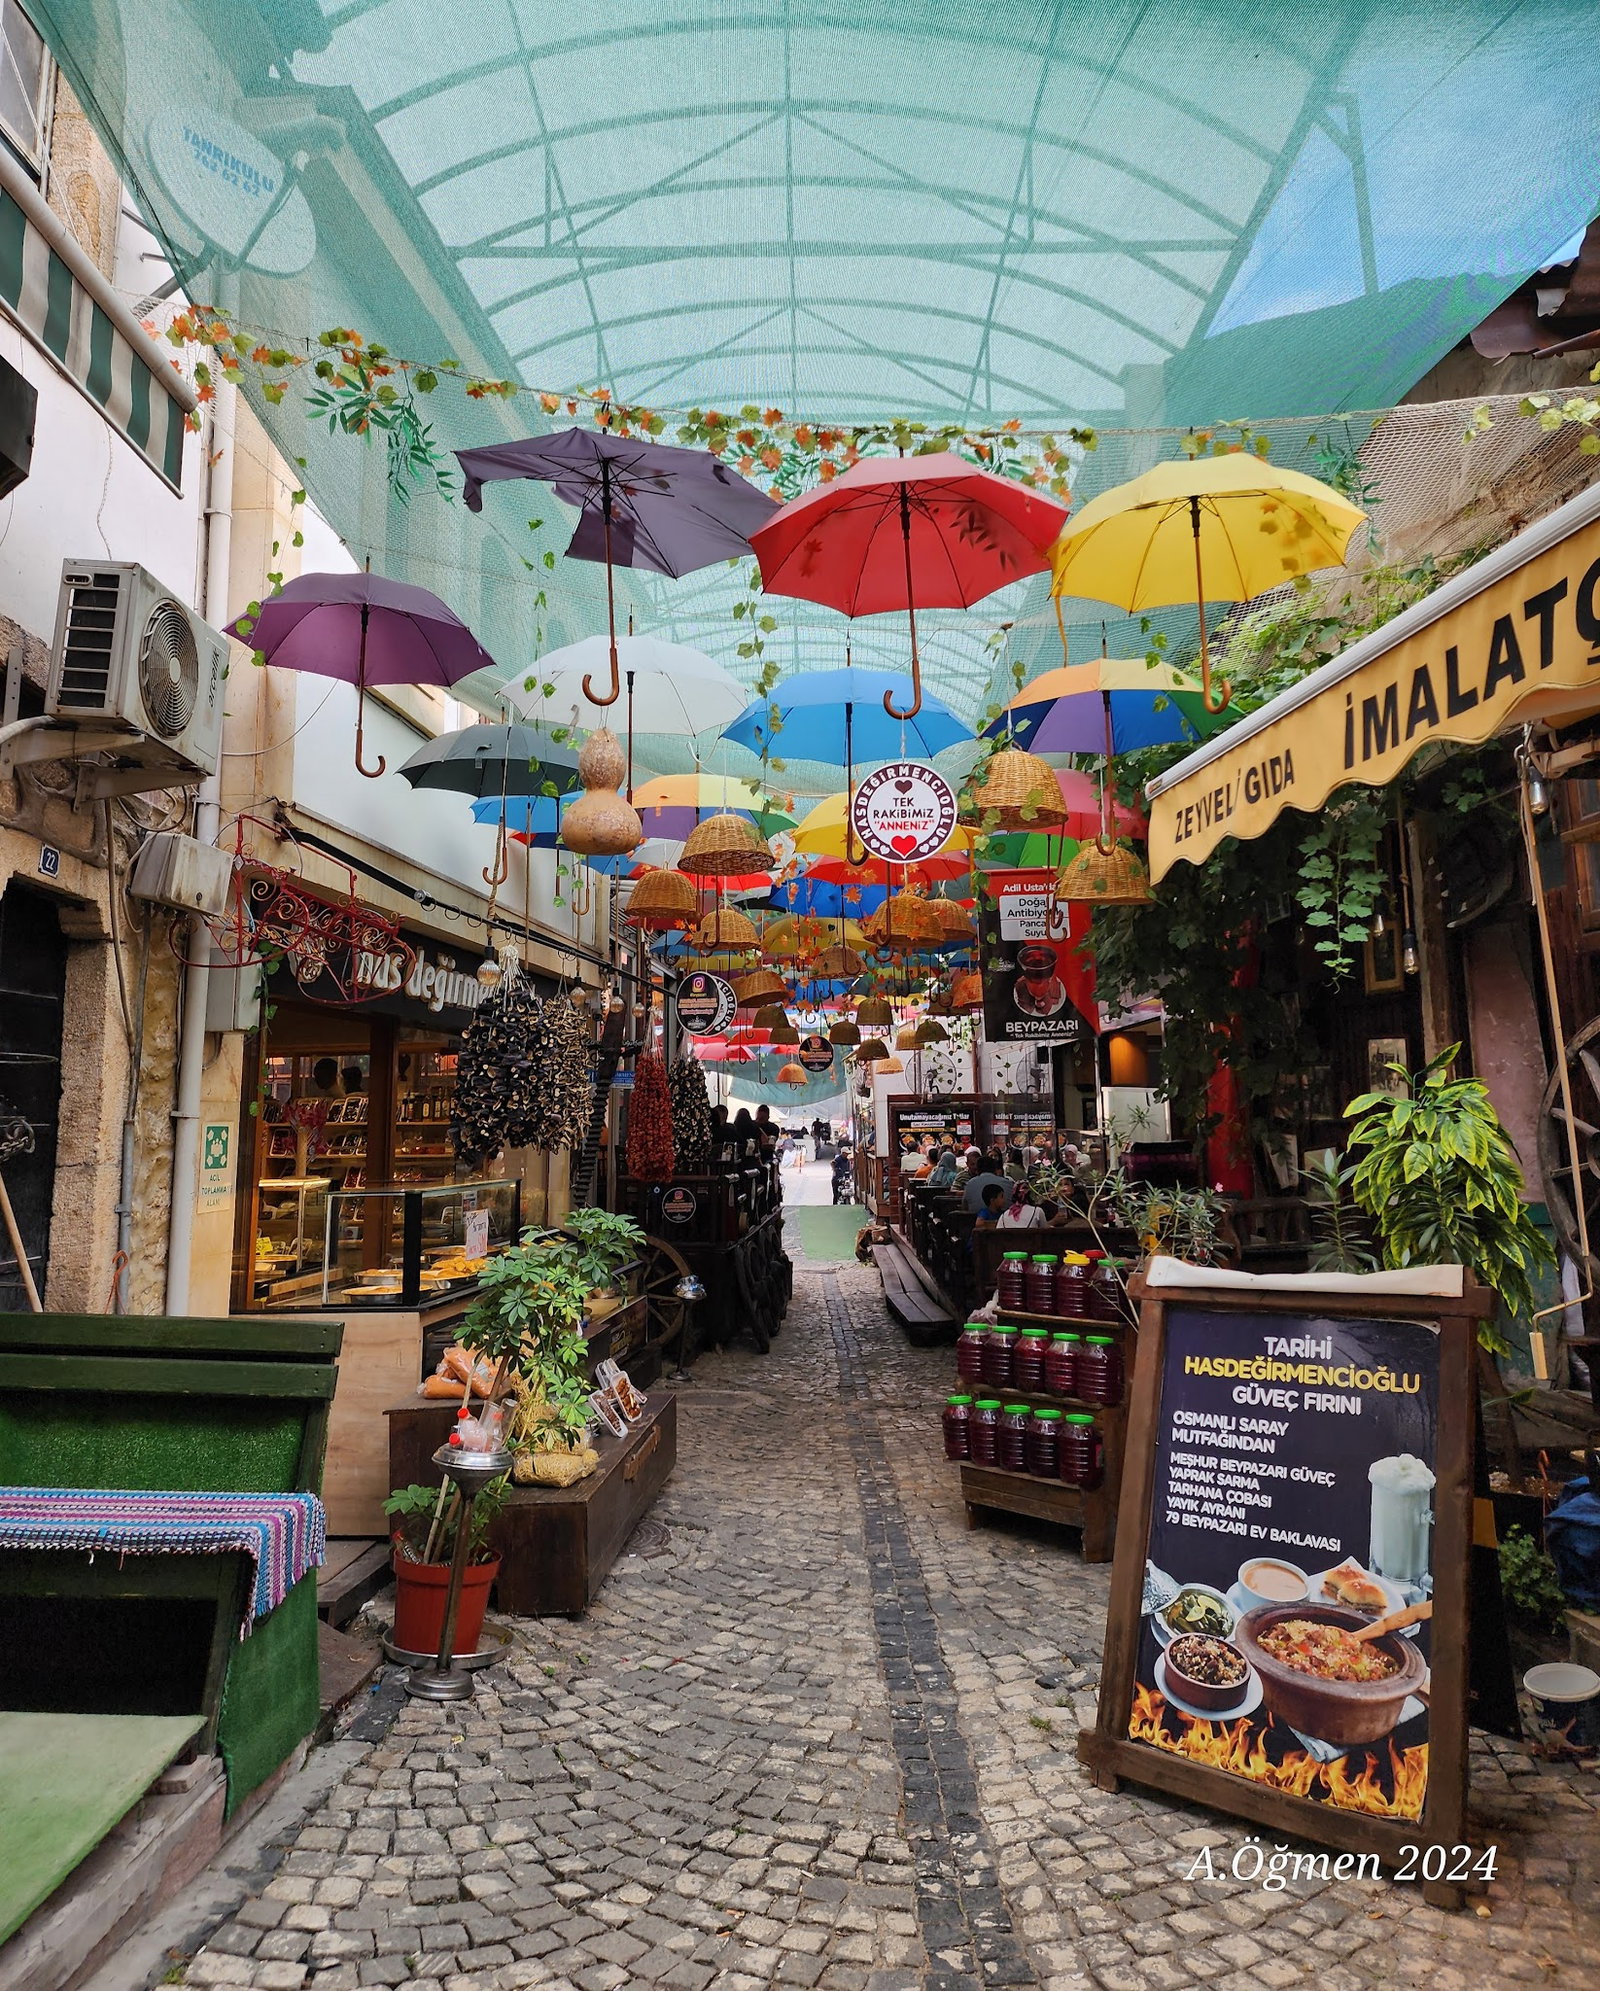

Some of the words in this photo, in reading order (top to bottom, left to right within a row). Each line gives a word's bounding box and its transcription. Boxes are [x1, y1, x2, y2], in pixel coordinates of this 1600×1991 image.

[1244, 748, 1295, 804] GIDA
[893, 797, 914, 807] TEK
[45, 851, 56, 871] 22
[1003, 884, 1021, 893] Adil
[1019, 897, 1048, 908] Doğa
[1020, 920, 1049, 928] Panca
[1006, 1020, 1079, 1033] BEYPAZARI
[1264, 1335, 1332, 1360] TARİHİ
[1185, 1356, 1420, 1394] HASDEĞİRMENCİOĞLU
[1233, 1383, 1299, 1412] GÜVEÇ
[1304, 1392, 1361, 1415] FIRINI
[1173, 1411, 1236, 1431] OSMANLI
[1239, 1417, 1289, 1436] SARAY
[1172, 1428, 1275, 1453] MUTFAĞINDAN
[1169, 1466, 1216, 1484] YAPRAK
[1217, 1473, 1260, 1491] SARMA
[1170, 1452, 1217, 1469] MEŞHUR
[1220, 1459, 1287, 1479] BEYPAZARI
[1290, 1466, 1336, 1487] GÜVEÇ
[1168, 1481, 1223, 1501] TARHANA
[1226, 1489, 1272, 1508] ÇOBASI
[1167, 1496, 1199, 1512] YAYIK
[1201, 1504, 1245, 1519] AYRANI
[1166, 1511, 1180, 1524] 79
[1182, 1513, 1247, 1536] BEYPAZARI
[1250, 1524, 1268, 1539] EV
[1270, 1528, 1341, 1551] BAKLAVASI
